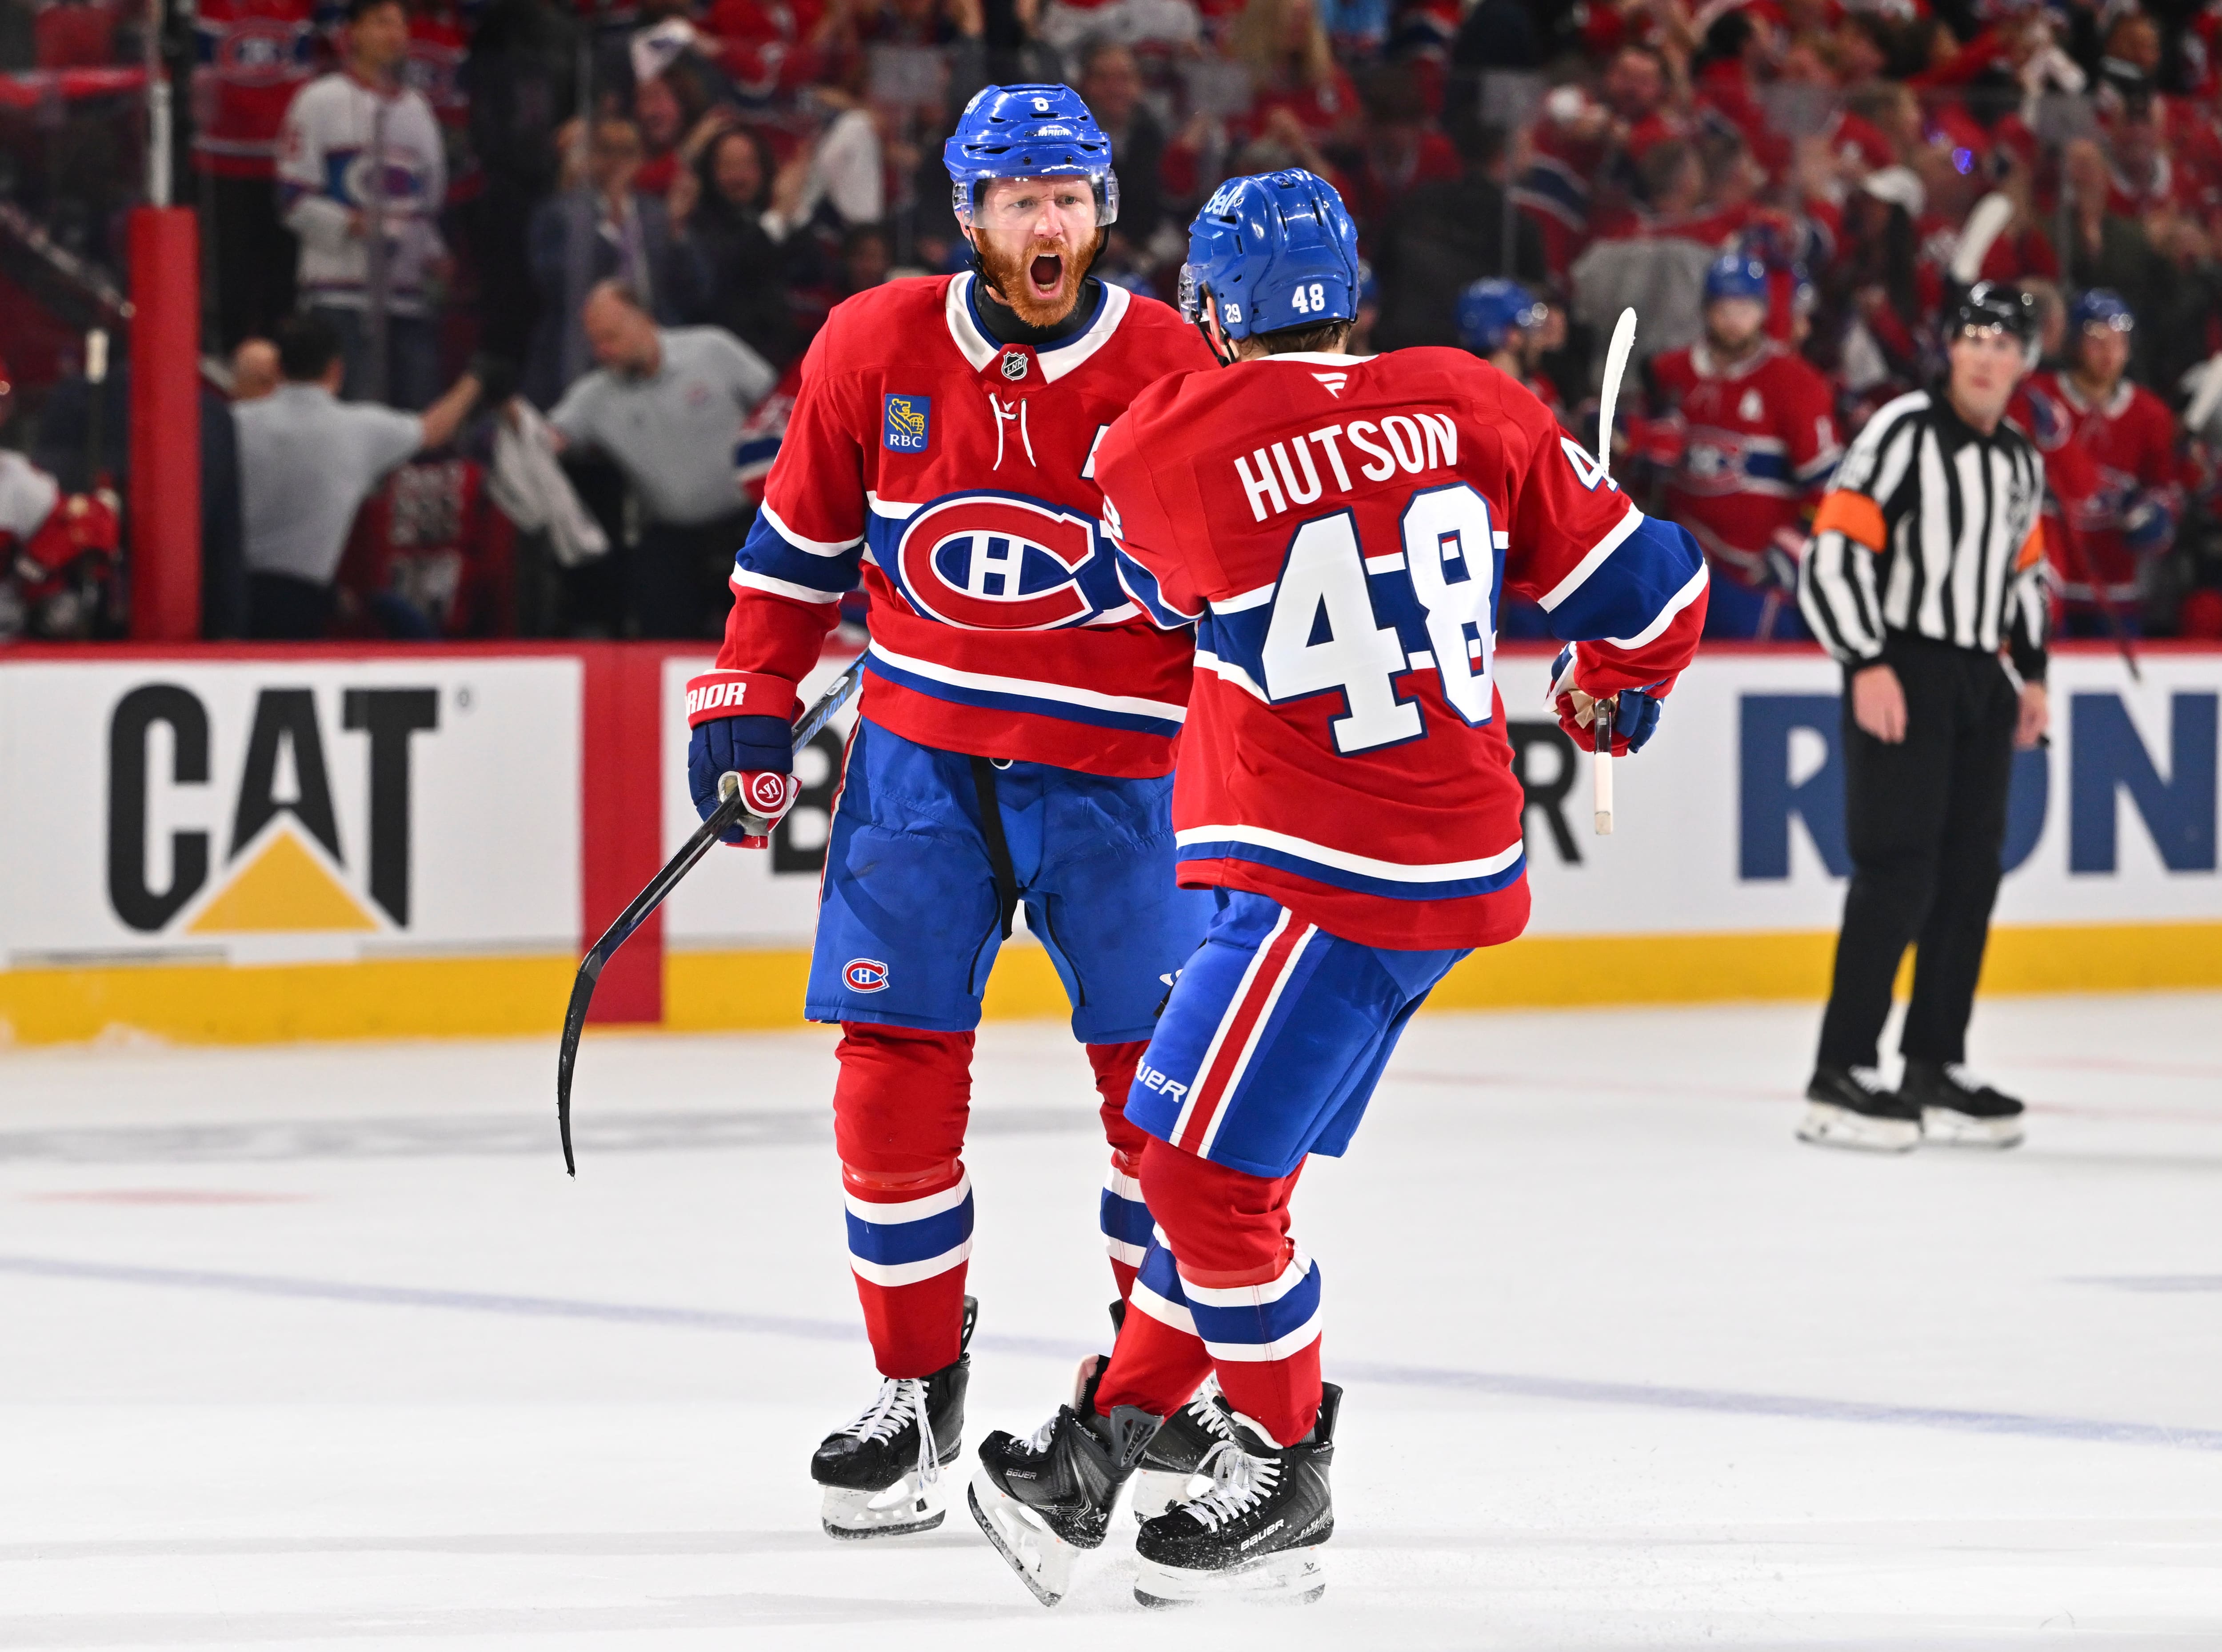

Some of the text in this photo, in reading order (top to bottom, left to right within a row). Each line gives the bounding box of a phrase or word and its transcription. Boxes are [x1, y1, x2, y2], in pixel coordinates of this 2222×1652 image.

[1204, 185, 1239, 217] Bell
[1224, 304, 1242, 323] 29
[1291, 283, 1325, 313] 48
[1007, 359, 1023, 374] LNH
[889, 434, 922, 448] RBC
[1234, 413, 1458, 522] HUTSON
[1260, 506, 1493, 758] 48
[685, 682, 747, 717] RIOR
[109, 685, 439, 934] CAT
